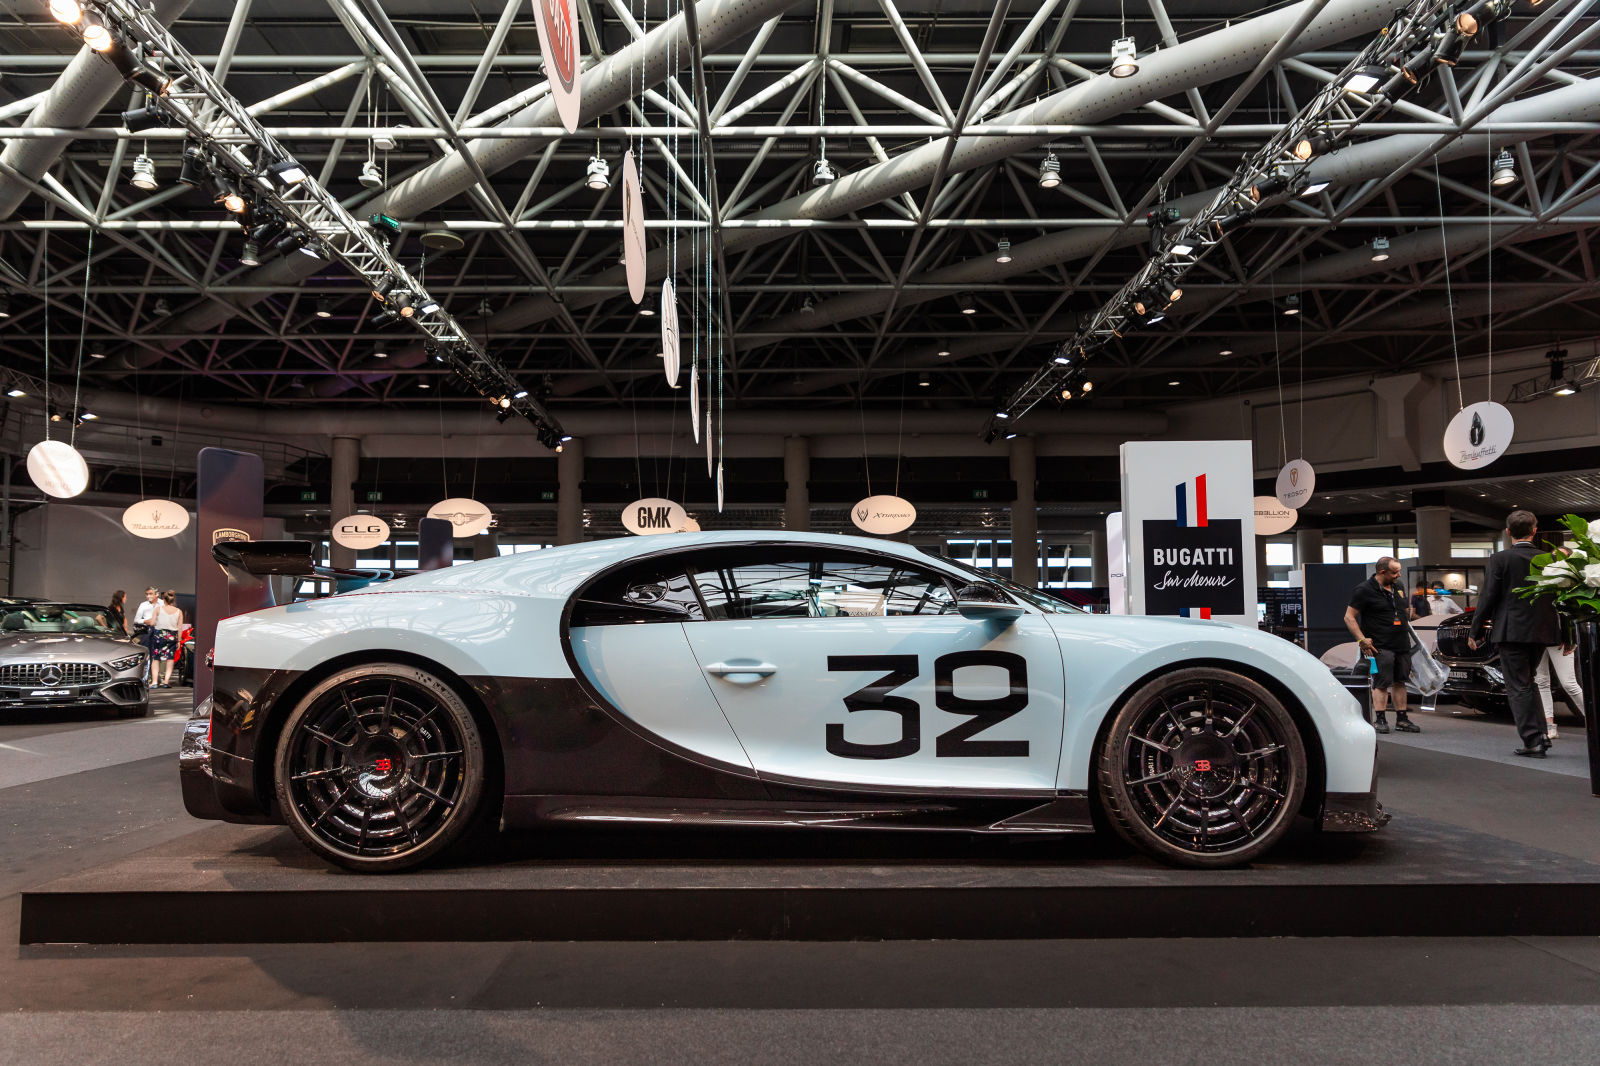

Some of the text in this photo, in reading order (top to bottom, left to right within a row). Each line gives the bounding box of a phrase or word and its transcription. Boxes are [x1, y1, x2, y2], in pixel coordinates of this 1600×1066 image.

[637, 506, 671, 529] GMK
[341, 525, 381, 533] CLG
[1153, 547, 1234, 566] BUGATTI
[1153, 570, 1236, 590] Sur Mesure
[825, 649, 1030, 760] 32
